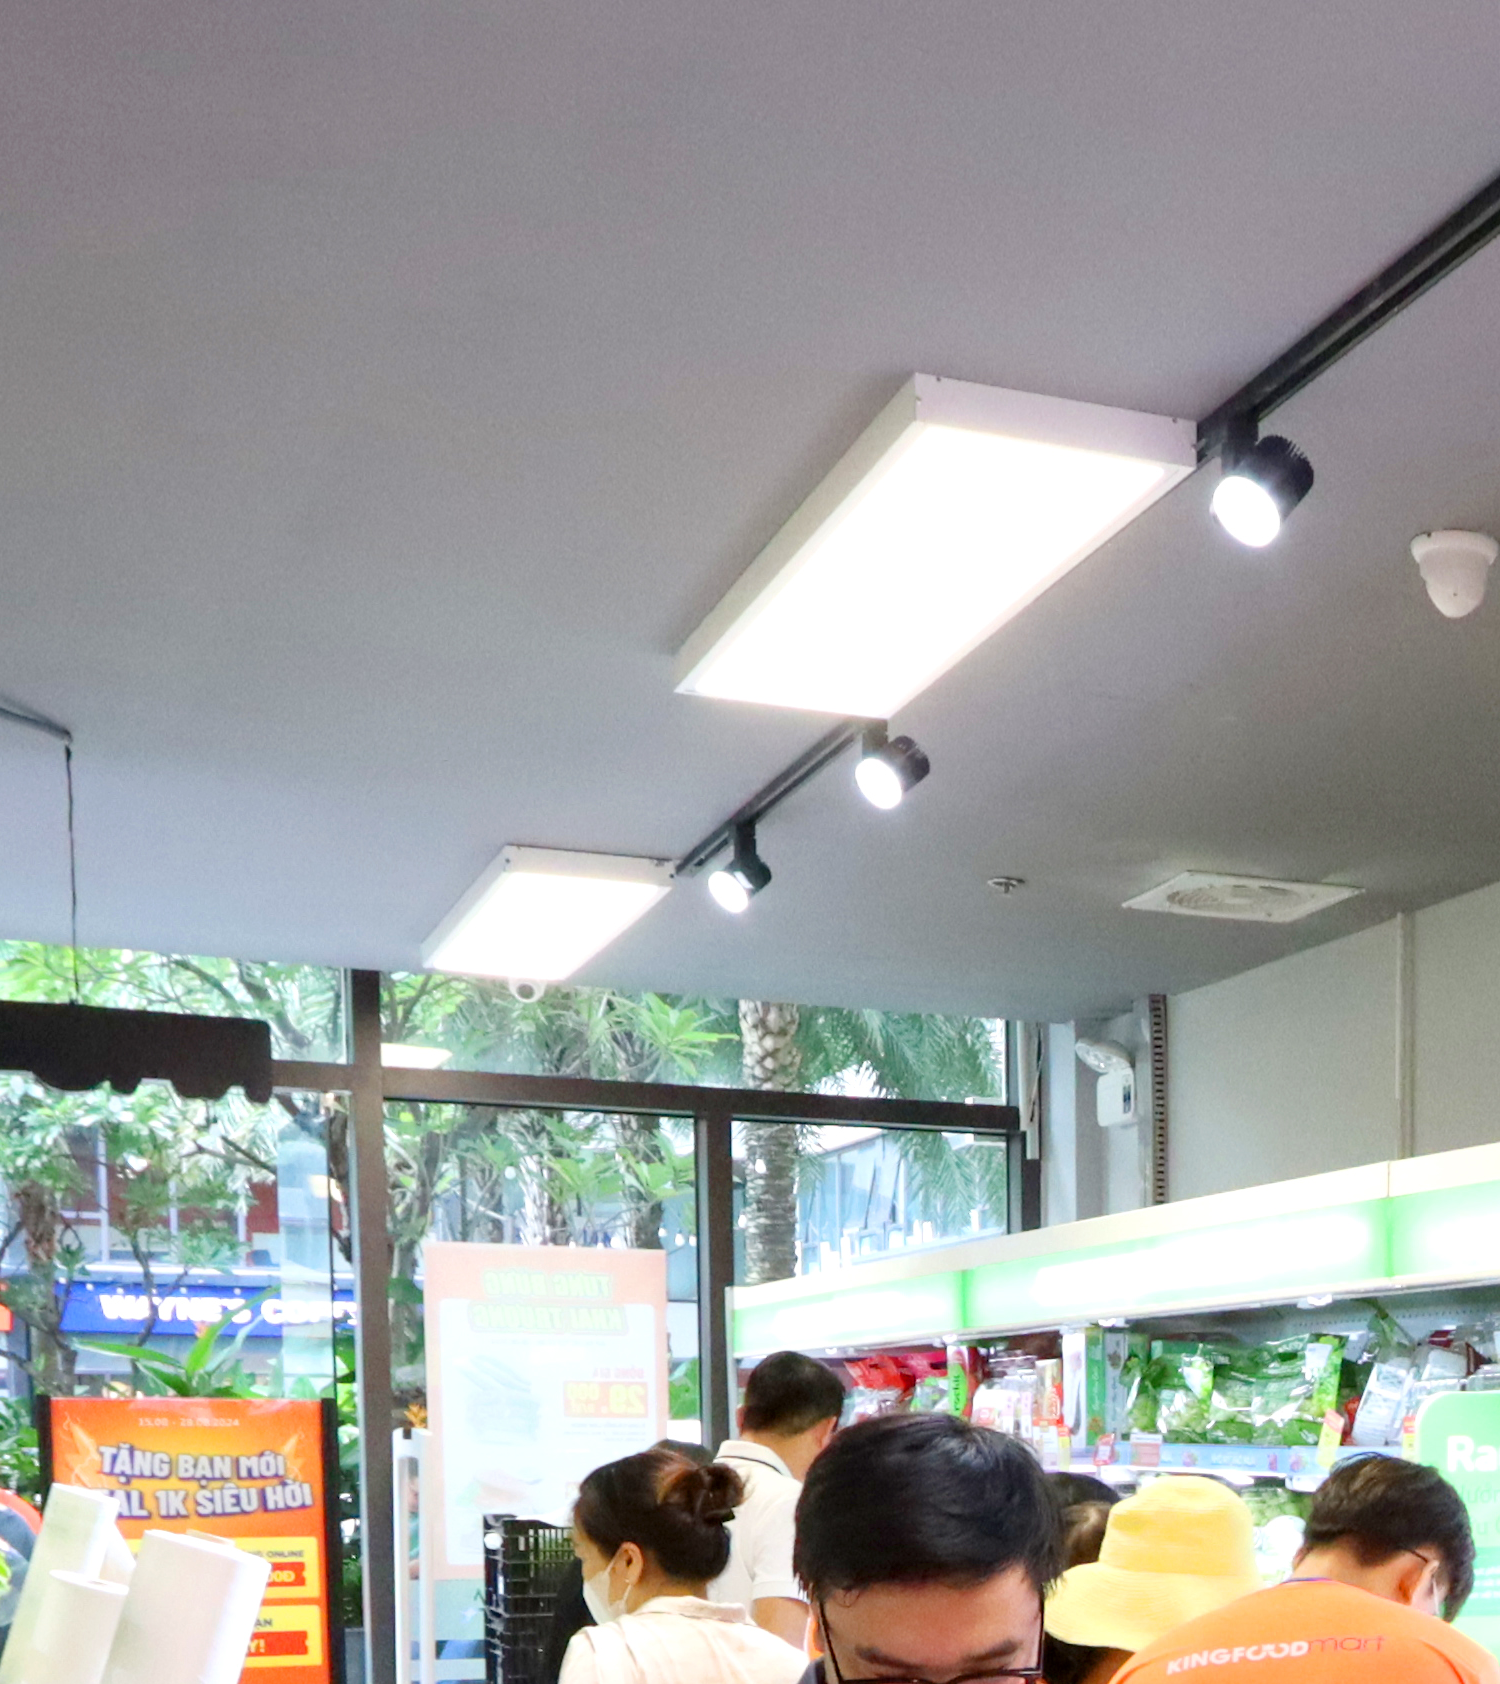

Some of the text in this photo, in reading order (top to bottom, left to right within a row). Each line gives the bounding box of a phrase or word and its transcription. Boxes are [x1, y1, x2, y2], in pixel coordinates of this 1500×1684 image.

[100, 1443, 286, 1486] TẶNG BẠN MỚI
[156, 1489, 190, 1517] 1K
[196, 1482, 258, 1516] SIÊU
[263, 1478, 314, 1511] HỜI
